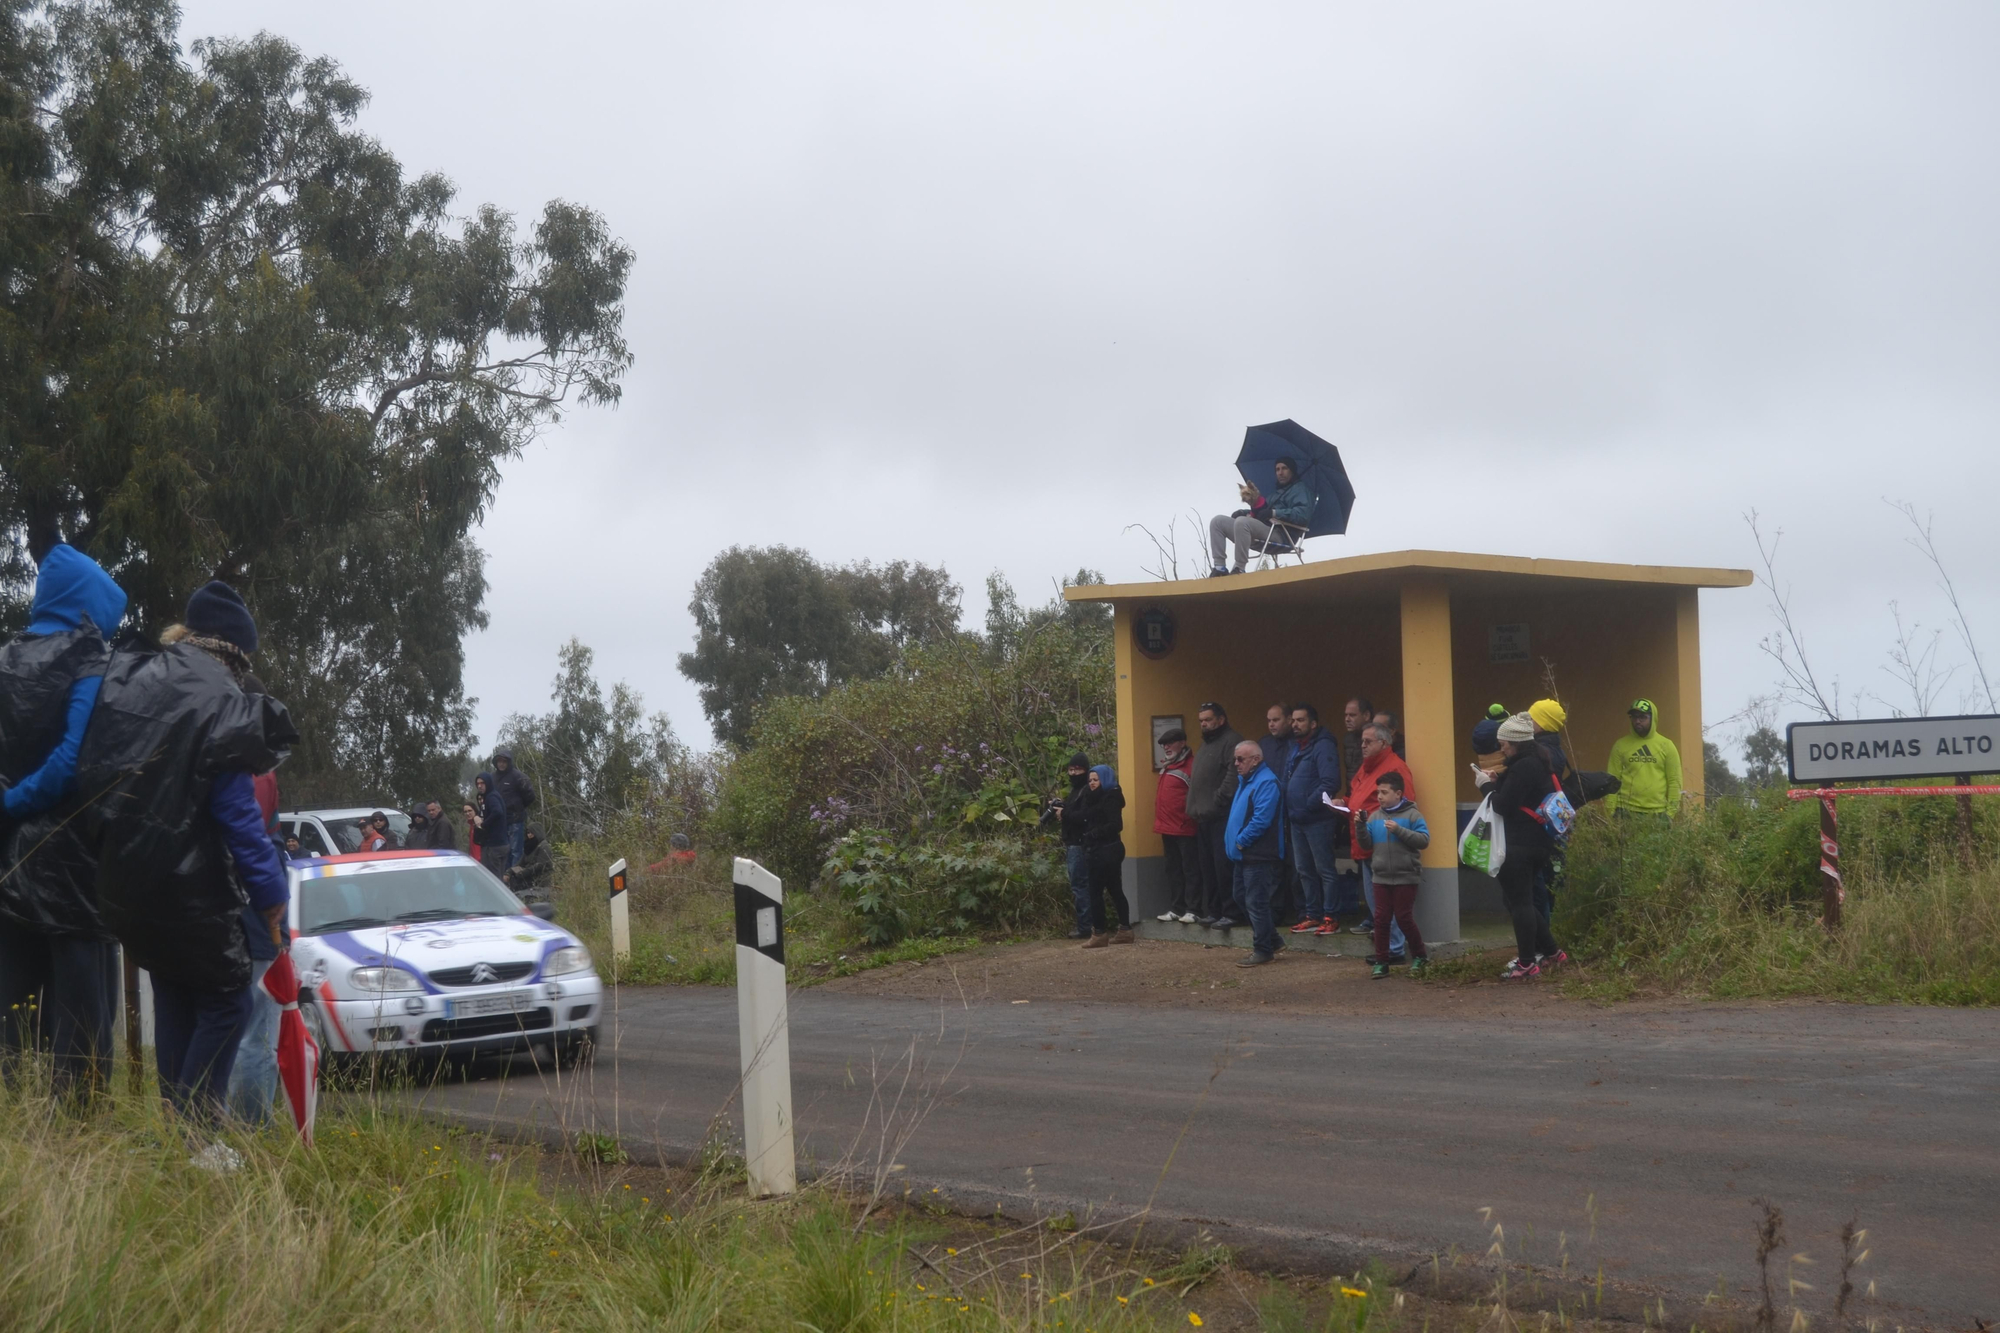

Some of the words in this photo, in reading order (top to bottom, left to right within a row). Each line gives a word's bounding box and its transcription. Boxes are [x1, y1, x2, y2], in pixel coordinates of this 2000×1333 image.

[1809, 738, 1921, 762] DORAMAS
[1936, 735, 1993, 756] ALTO
[1628, 756, 1657, 764] adidas
